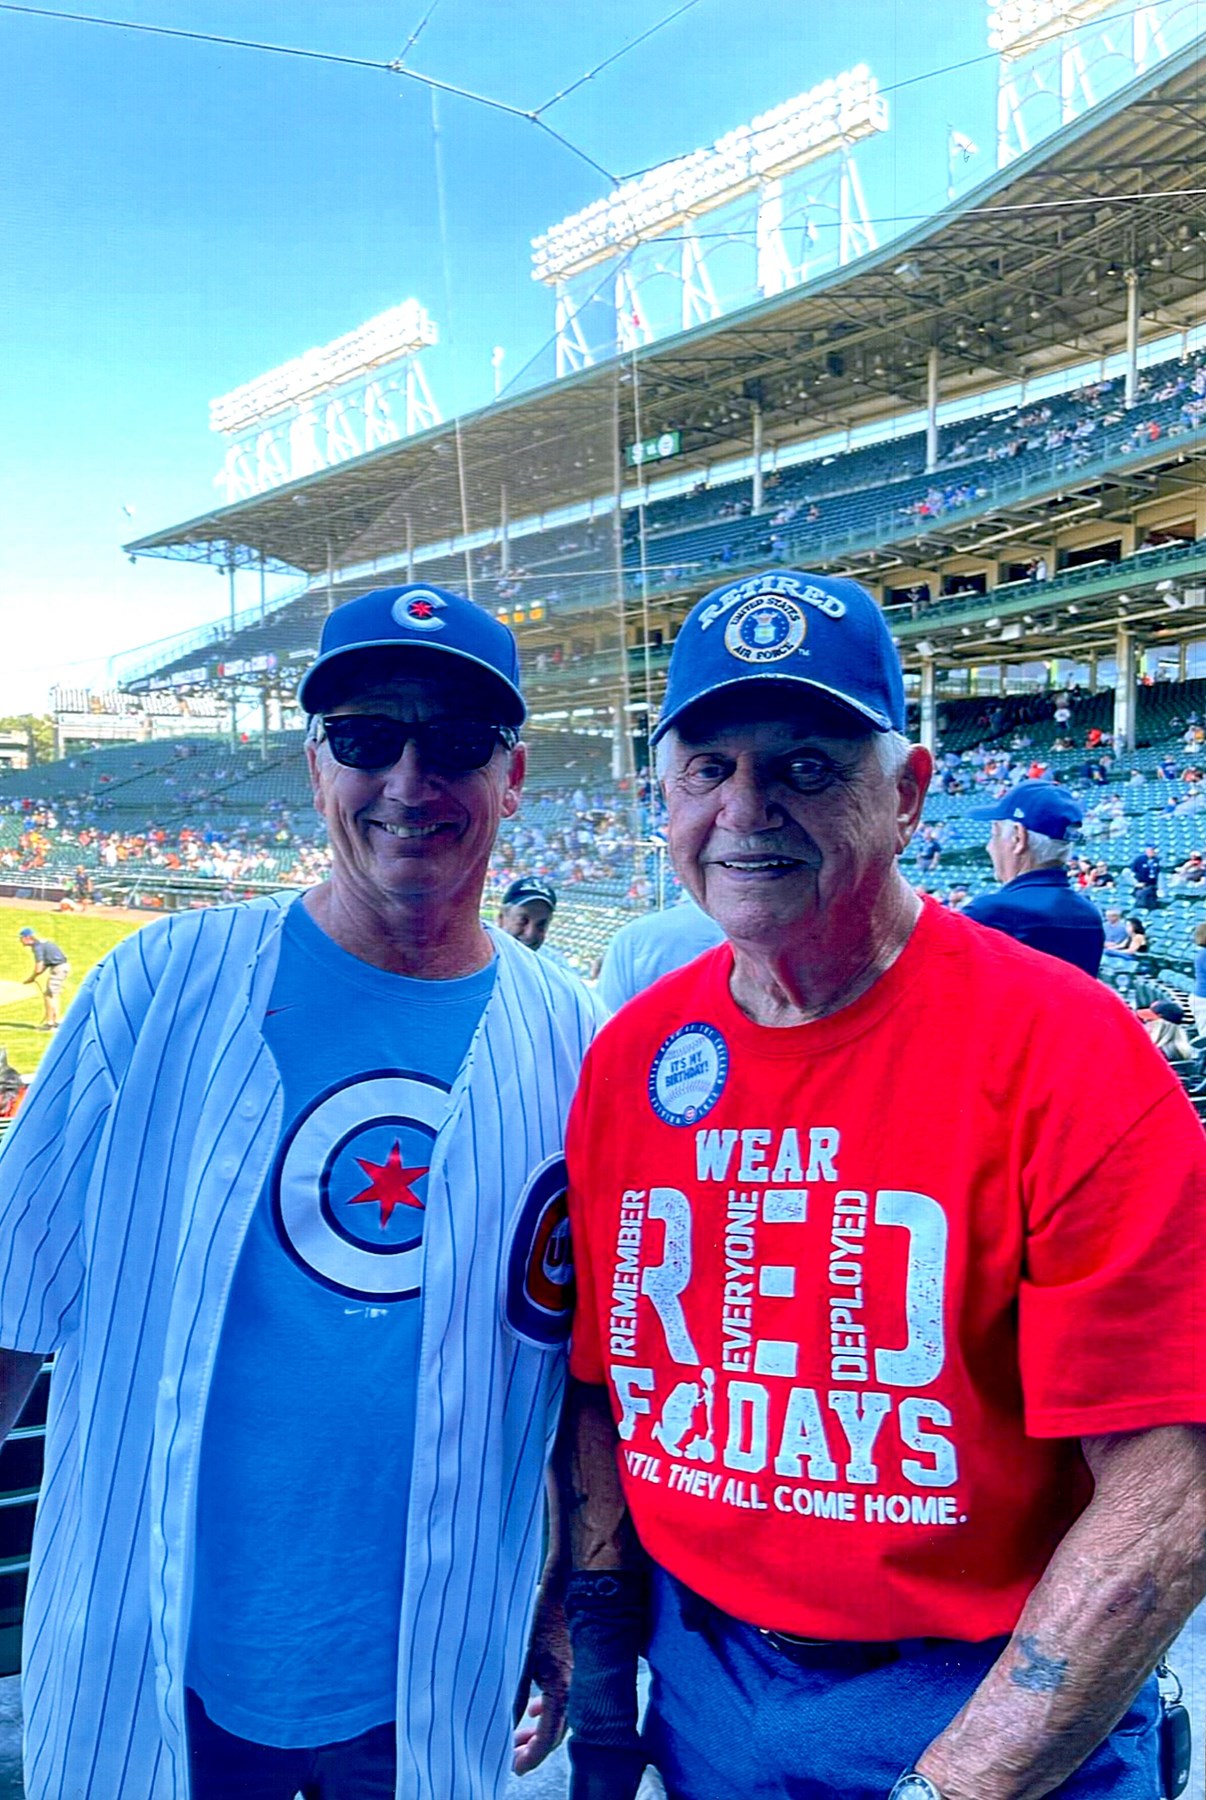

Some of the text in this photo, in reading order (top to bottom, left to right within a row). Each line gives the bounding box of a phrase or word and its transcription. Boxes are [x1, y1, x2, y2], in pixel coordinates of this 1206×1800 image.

[698, 575, 847, 631] RETIRED
[730, 597, 801, 625] UNITED STATES
[733, 642, 794, 659] AIR FORCE
[665, 1061, 709, 1088] BIRTHDAY!
[689, 1050, 703, 1066] MY
[695, 1127, 841, 1182] WEAR
[610, 1189, 647, 1358] REMEMBER
[722, 1189, 759, 1372] EVERYONE
[829, 1189, 869, 1382] DEPLOYED
[668, 1465, 723, 1500] THEY
[721, 1478, 768, 1510] ALL
[774, 1485, 856, 1522] COME
[864, 1494, 968, 1525] HOME.
